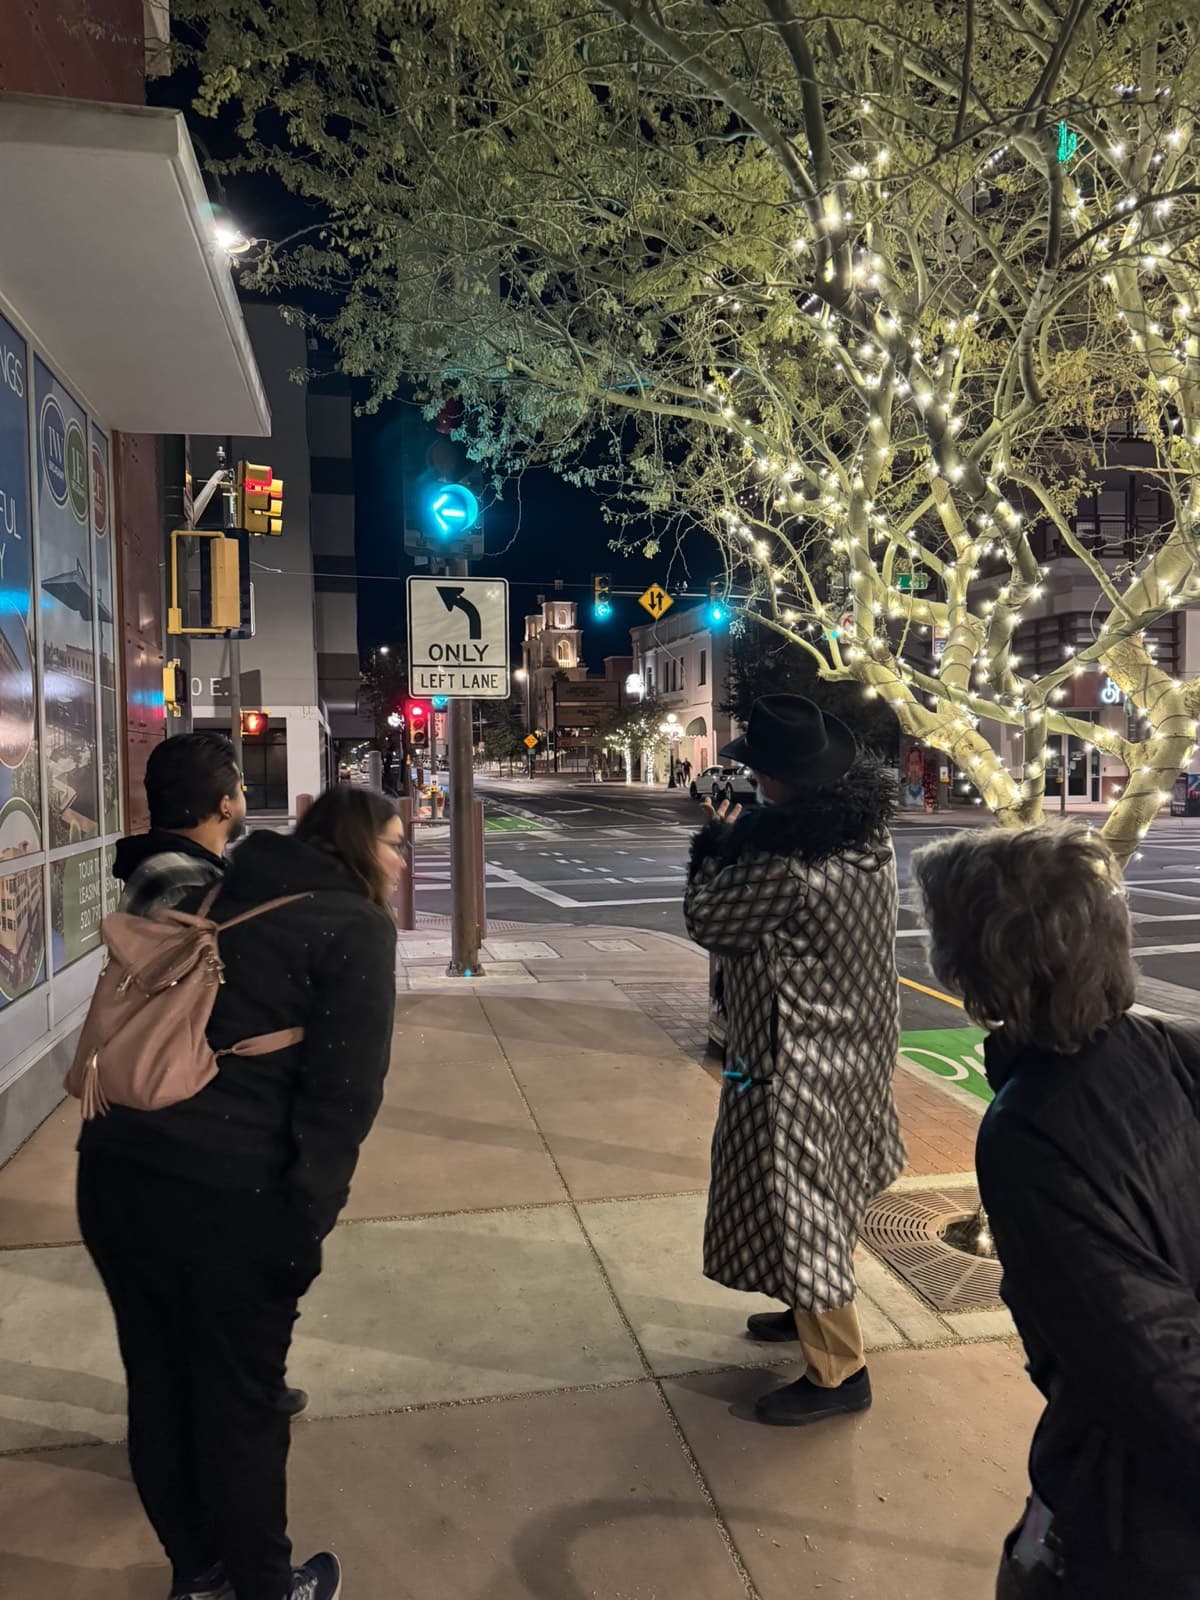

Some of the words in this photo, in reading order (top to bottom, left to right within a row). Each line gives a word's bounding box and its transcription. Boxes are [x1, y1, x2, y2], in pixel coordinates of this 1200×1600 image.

[428, 643, 490, 662] ONLY
[420, 673, 456, 689] LEFT
[461, 674, 499, 689] LANE
[78, 859, 94, 880] TOUR
